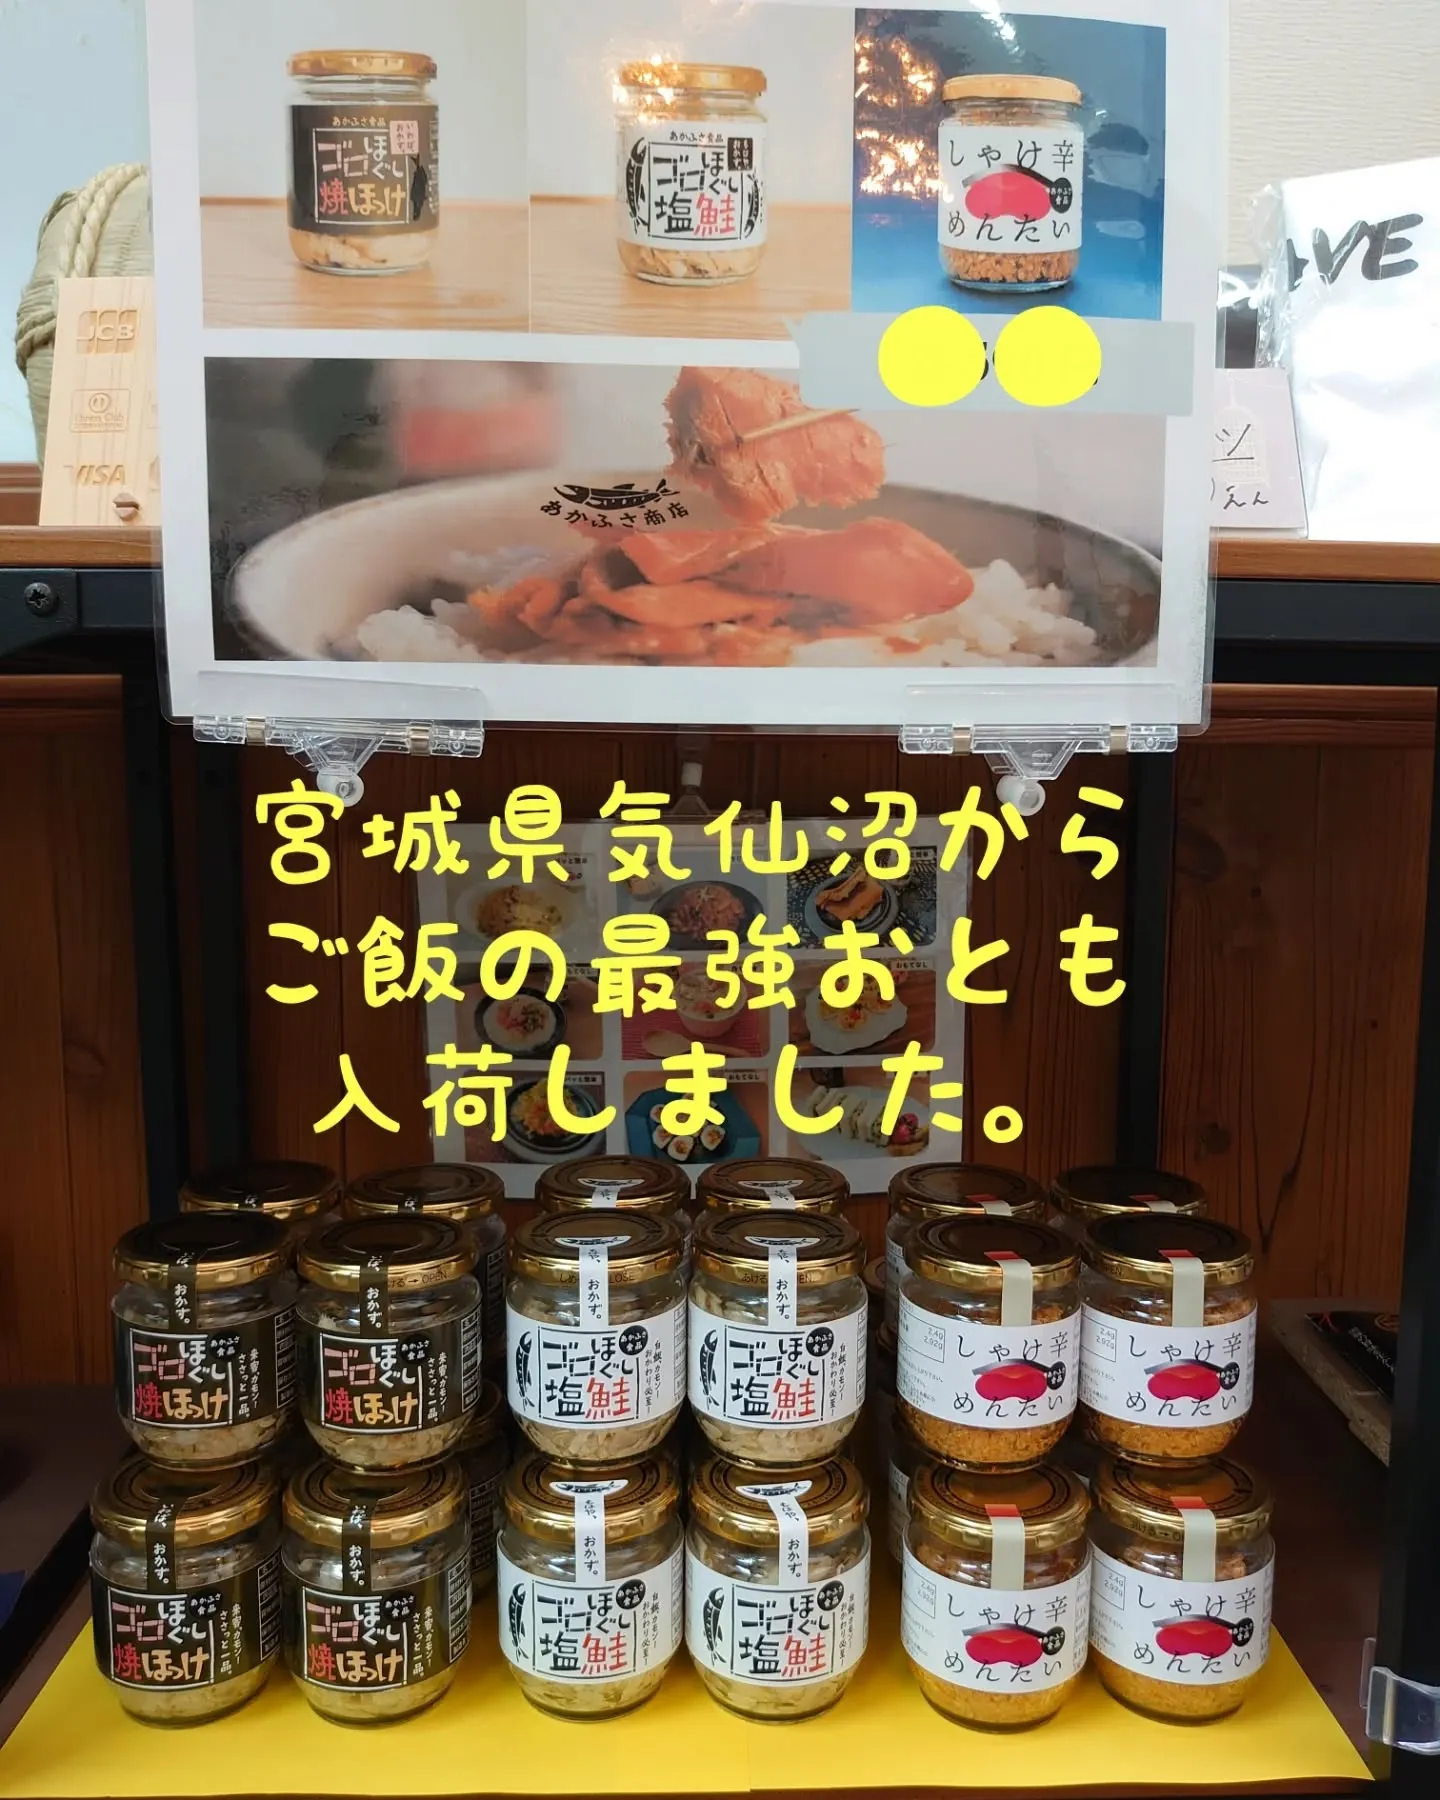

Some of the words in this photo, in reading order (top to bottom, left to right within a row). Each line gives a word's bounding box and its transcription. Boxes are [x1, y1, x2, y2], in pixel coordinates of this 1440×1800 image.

[332, 115, 386, 127] あかふさ食品
[949, 139, 1074, 172] しゃけ辛
[319, 177, 406, 217] 焼ほっけ
[654, 191, 736, 237] 塩鮭
[948, 210, 1070, 243] めんたい
[63, 464, 126, 486] VISA
[540, 500, 689, 528] あかふさ商店
[422, 1270, 447, 1284] OPEN
[608, 1271, 637, 1284] LOSE
[957, 1331, 1068, 1362] しゃけ辛
[1128, 1332, 1242, 1362] しゃけ辛
[135, 1381, 229, 1420] 焼ほっけ
[325, 1387, 418, 1425] 焼ほっけ
[544, 1375, 632, 1420] 塩鮭
[730, 1376, 816, 1420] 塩鮭
[953, 1391, 1063, 1417] めんたい
[1126, 1391, 1236, 1416] めんたい
[947, 1593, 1067, 1626] しゃけ辛
[1137, 1584, 1257, 1617] しゃけ辛
[114, 1642, 209, 1681] 焼ほっけ
[308, 1643, 404, 1683] 焼ほっけ
[539, 1631, 628, 1675] 塩鮭
[738, 1632, 827, 1677] 塩鮭
[944, 1650, 1062, 1682] めんたい
[1133, 1641, 1250, 1674] めんたい
